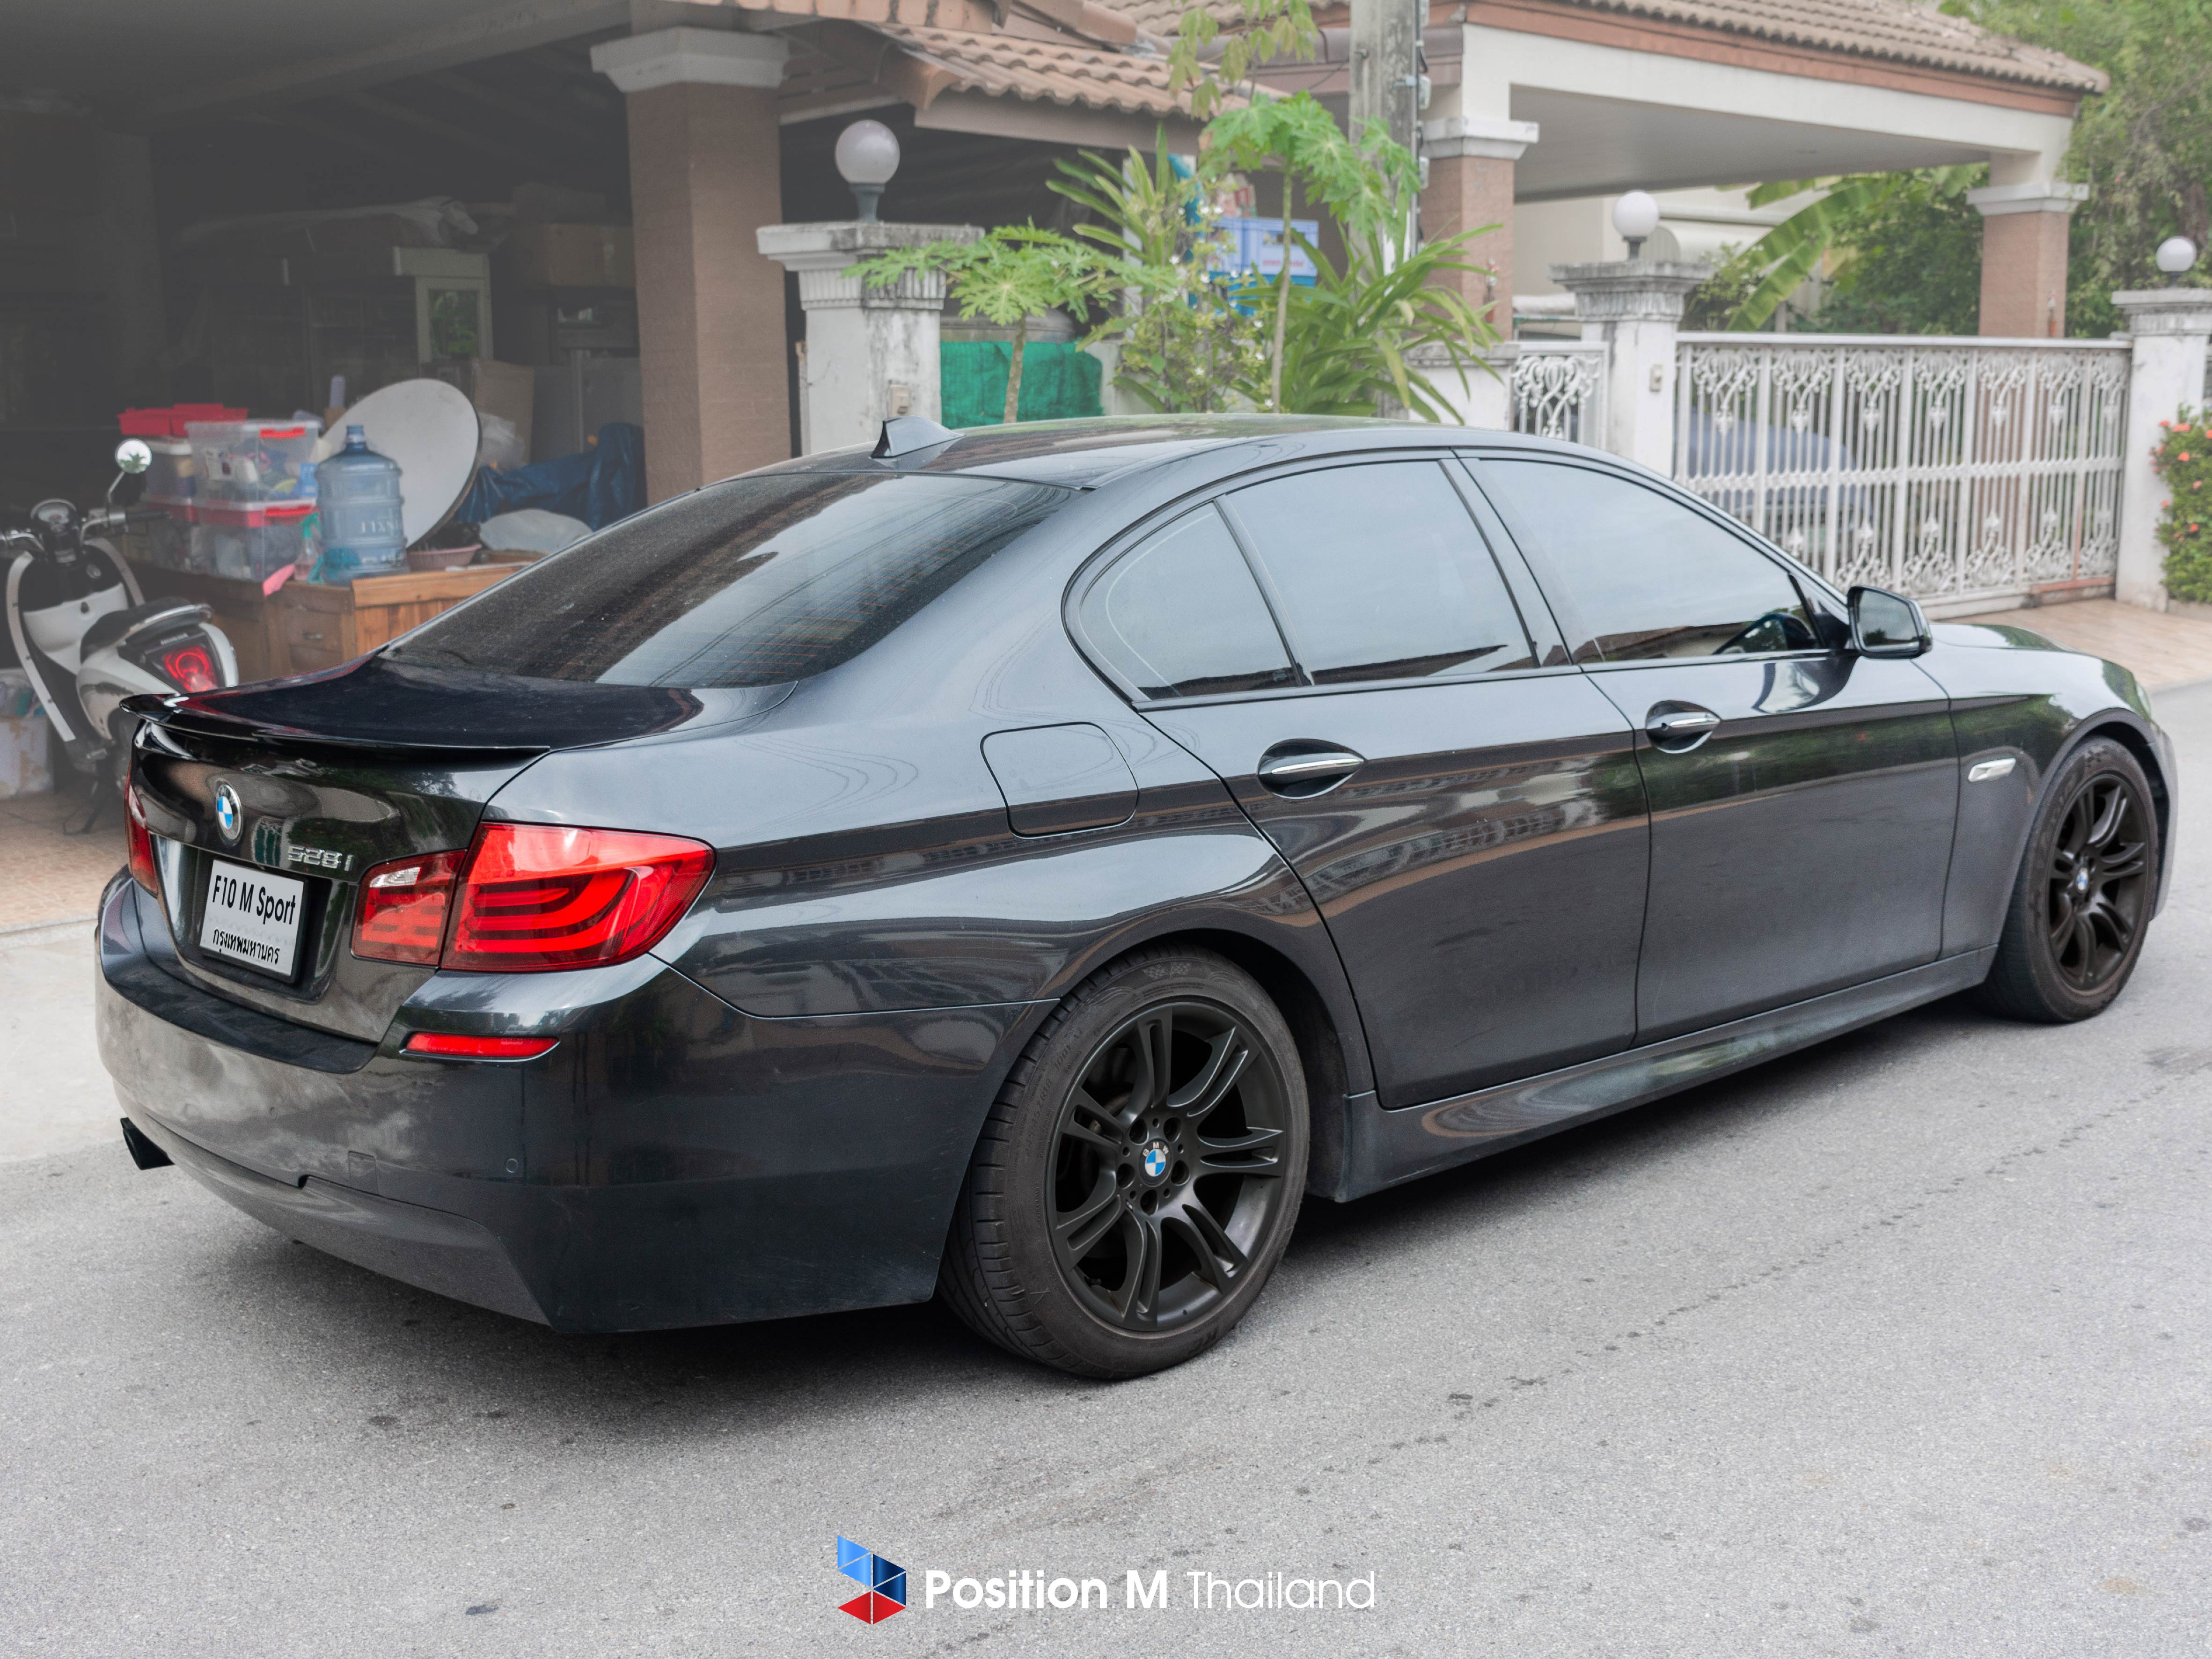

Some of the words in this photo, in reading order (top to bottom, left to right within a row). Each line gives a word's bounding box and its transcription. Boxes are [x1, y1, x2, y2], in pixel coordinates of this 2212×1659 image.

[287, 845, 355, 871] 528i
[212, 875, 237, 908] F10
[239, 882, 254, 913] M
[256, 886, 296, 925] Sport
[212, 928, 280, 965] กรุงเทพมหานคร
[1143, 1142, 1169, 1157] BMW
